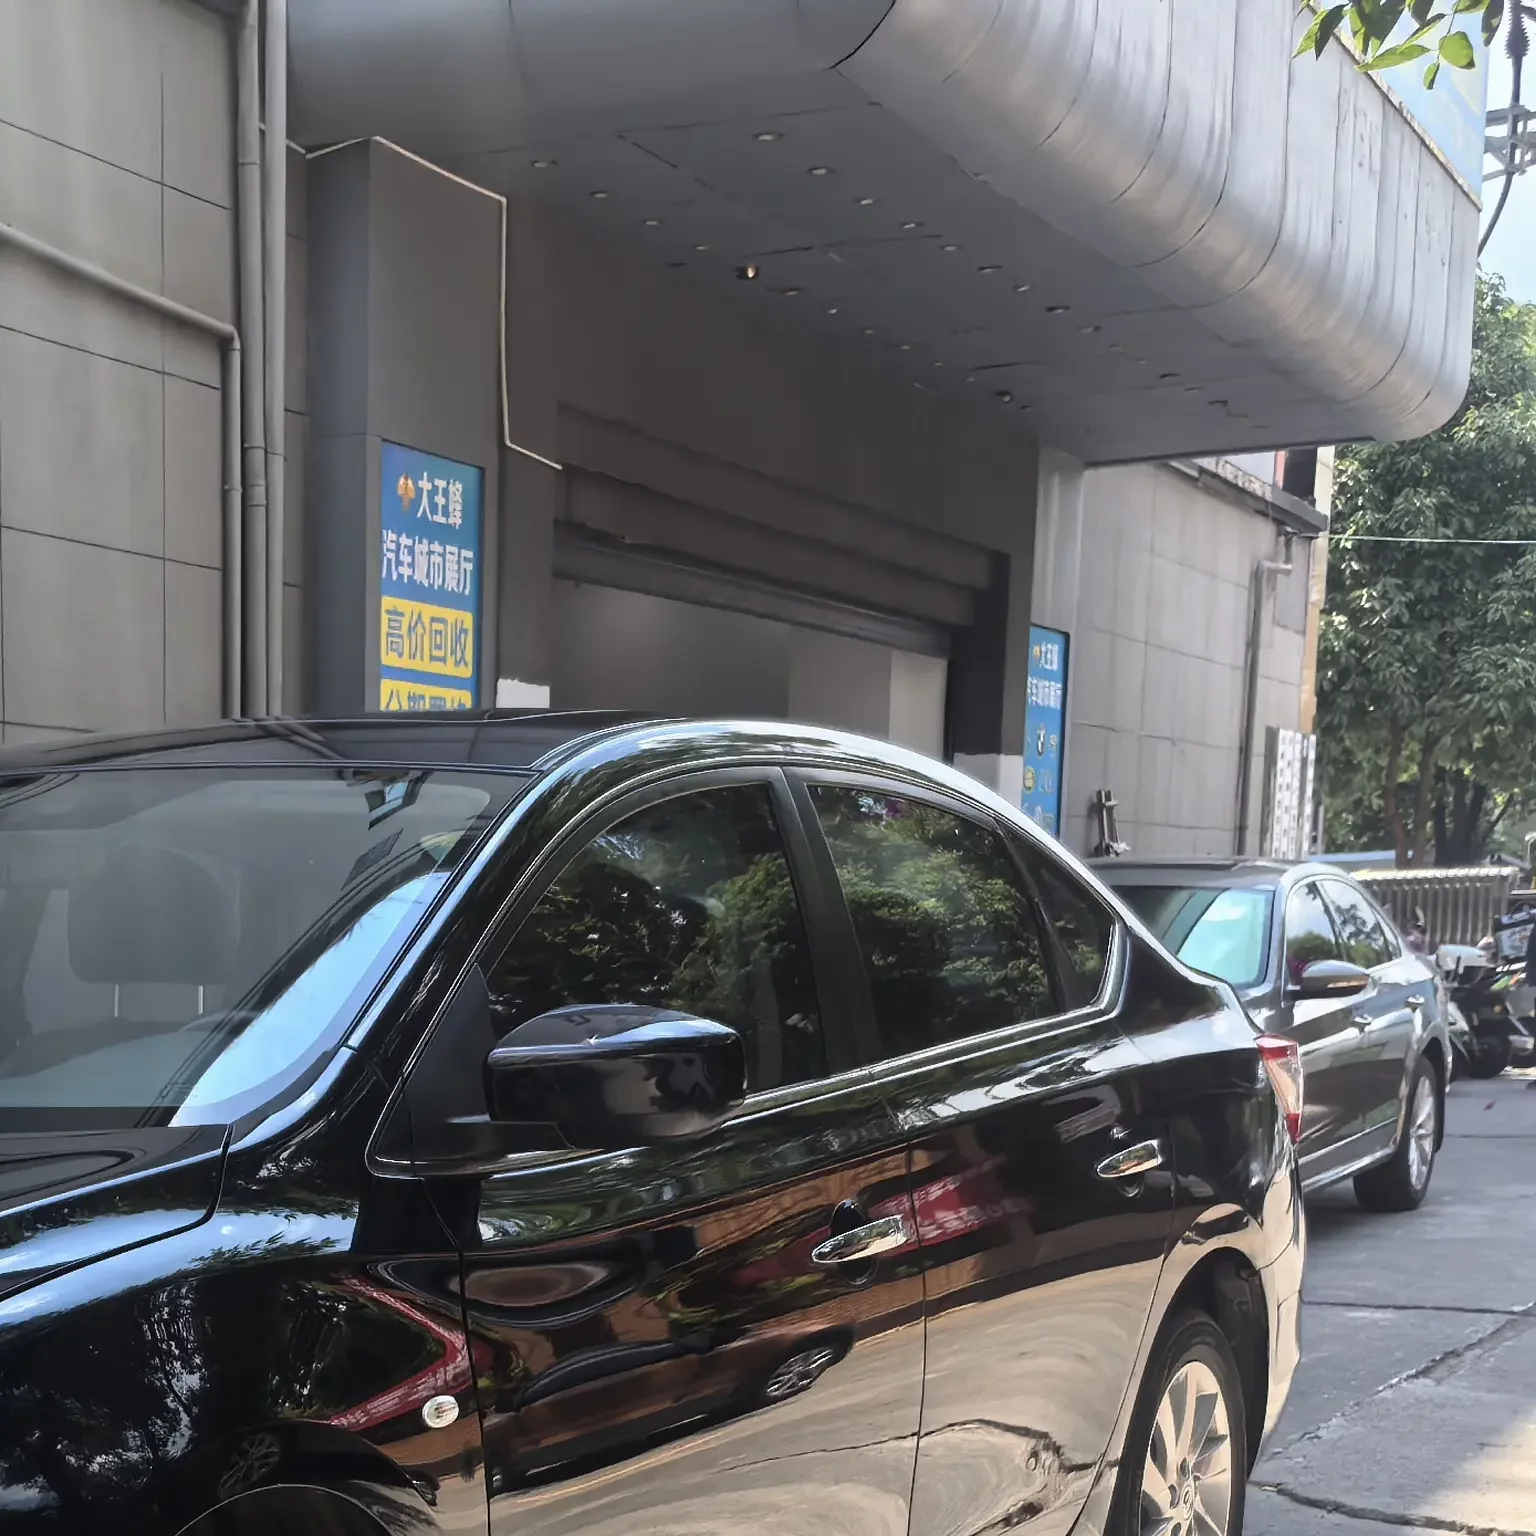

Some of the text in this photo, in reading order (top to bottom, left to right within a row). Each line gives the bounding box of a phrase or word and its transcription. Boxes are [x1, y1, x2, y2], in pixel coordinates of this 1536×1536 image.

[381, 529, 474, 595] 汽车城市展厅
[384, 606, 469, 668] 高价回收
